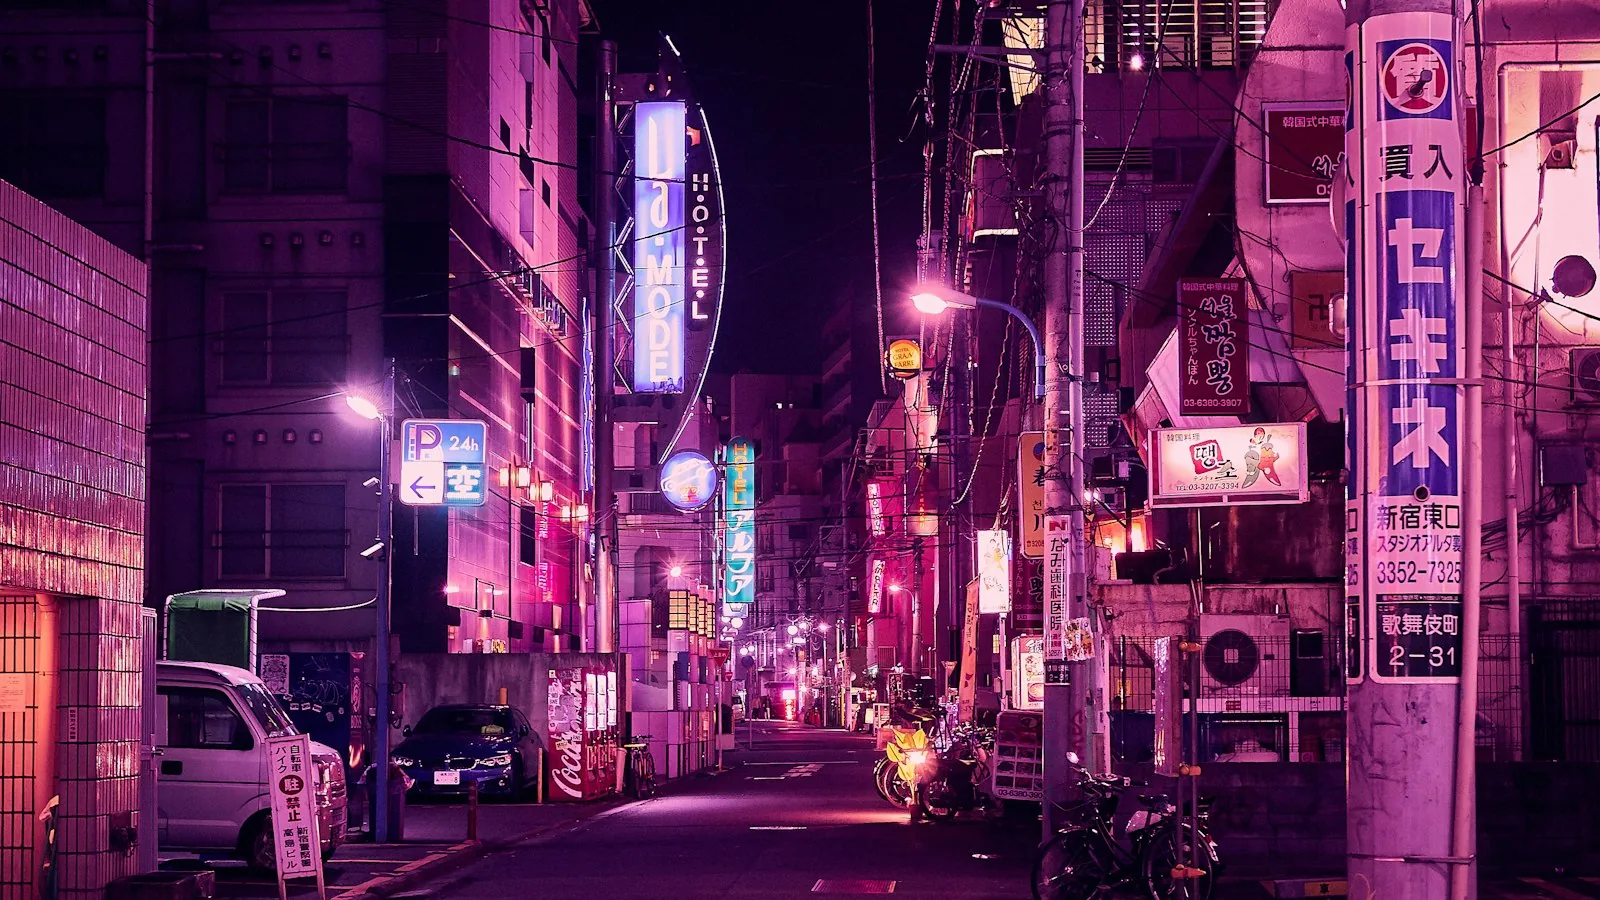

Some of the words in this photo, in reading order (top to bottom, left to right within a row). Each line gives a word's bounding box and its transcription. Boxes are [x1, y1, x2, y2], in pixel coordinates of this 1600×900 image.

[1282, 116, 1345, 128] 韓国式中華
[1379, 144, 1453, 182] 買入
[1183, 283, 1239, 292] 韓国式中華料理
[1388, 217, 1450, 468] セキネ
[1184, 398, 1242, 408] 03-6380-3907
[449, 435, 479, 452] 24h
[447, 464, 481, 499] 空
[733, 442, 748, 505] HOTEL
[1377, 503, 1460, 531] 新宿東口
[1377, 534, 1462, 553] スタジオアルタ裏
[1050, 537, 1066, 632] なみ歯科医院
[1377, 561, 1462, 585] 3352-7325
[1382, 614, 1459, 636] 歌舞伎町
[1389, 646, 1455, 667] 2-31
[276, 746, 288, 774] バイク
[290, 744, 302, 773] 自転車
[285, 797, 302, 822] 禁止
[283, 828, 298, 870] 高島ビル
